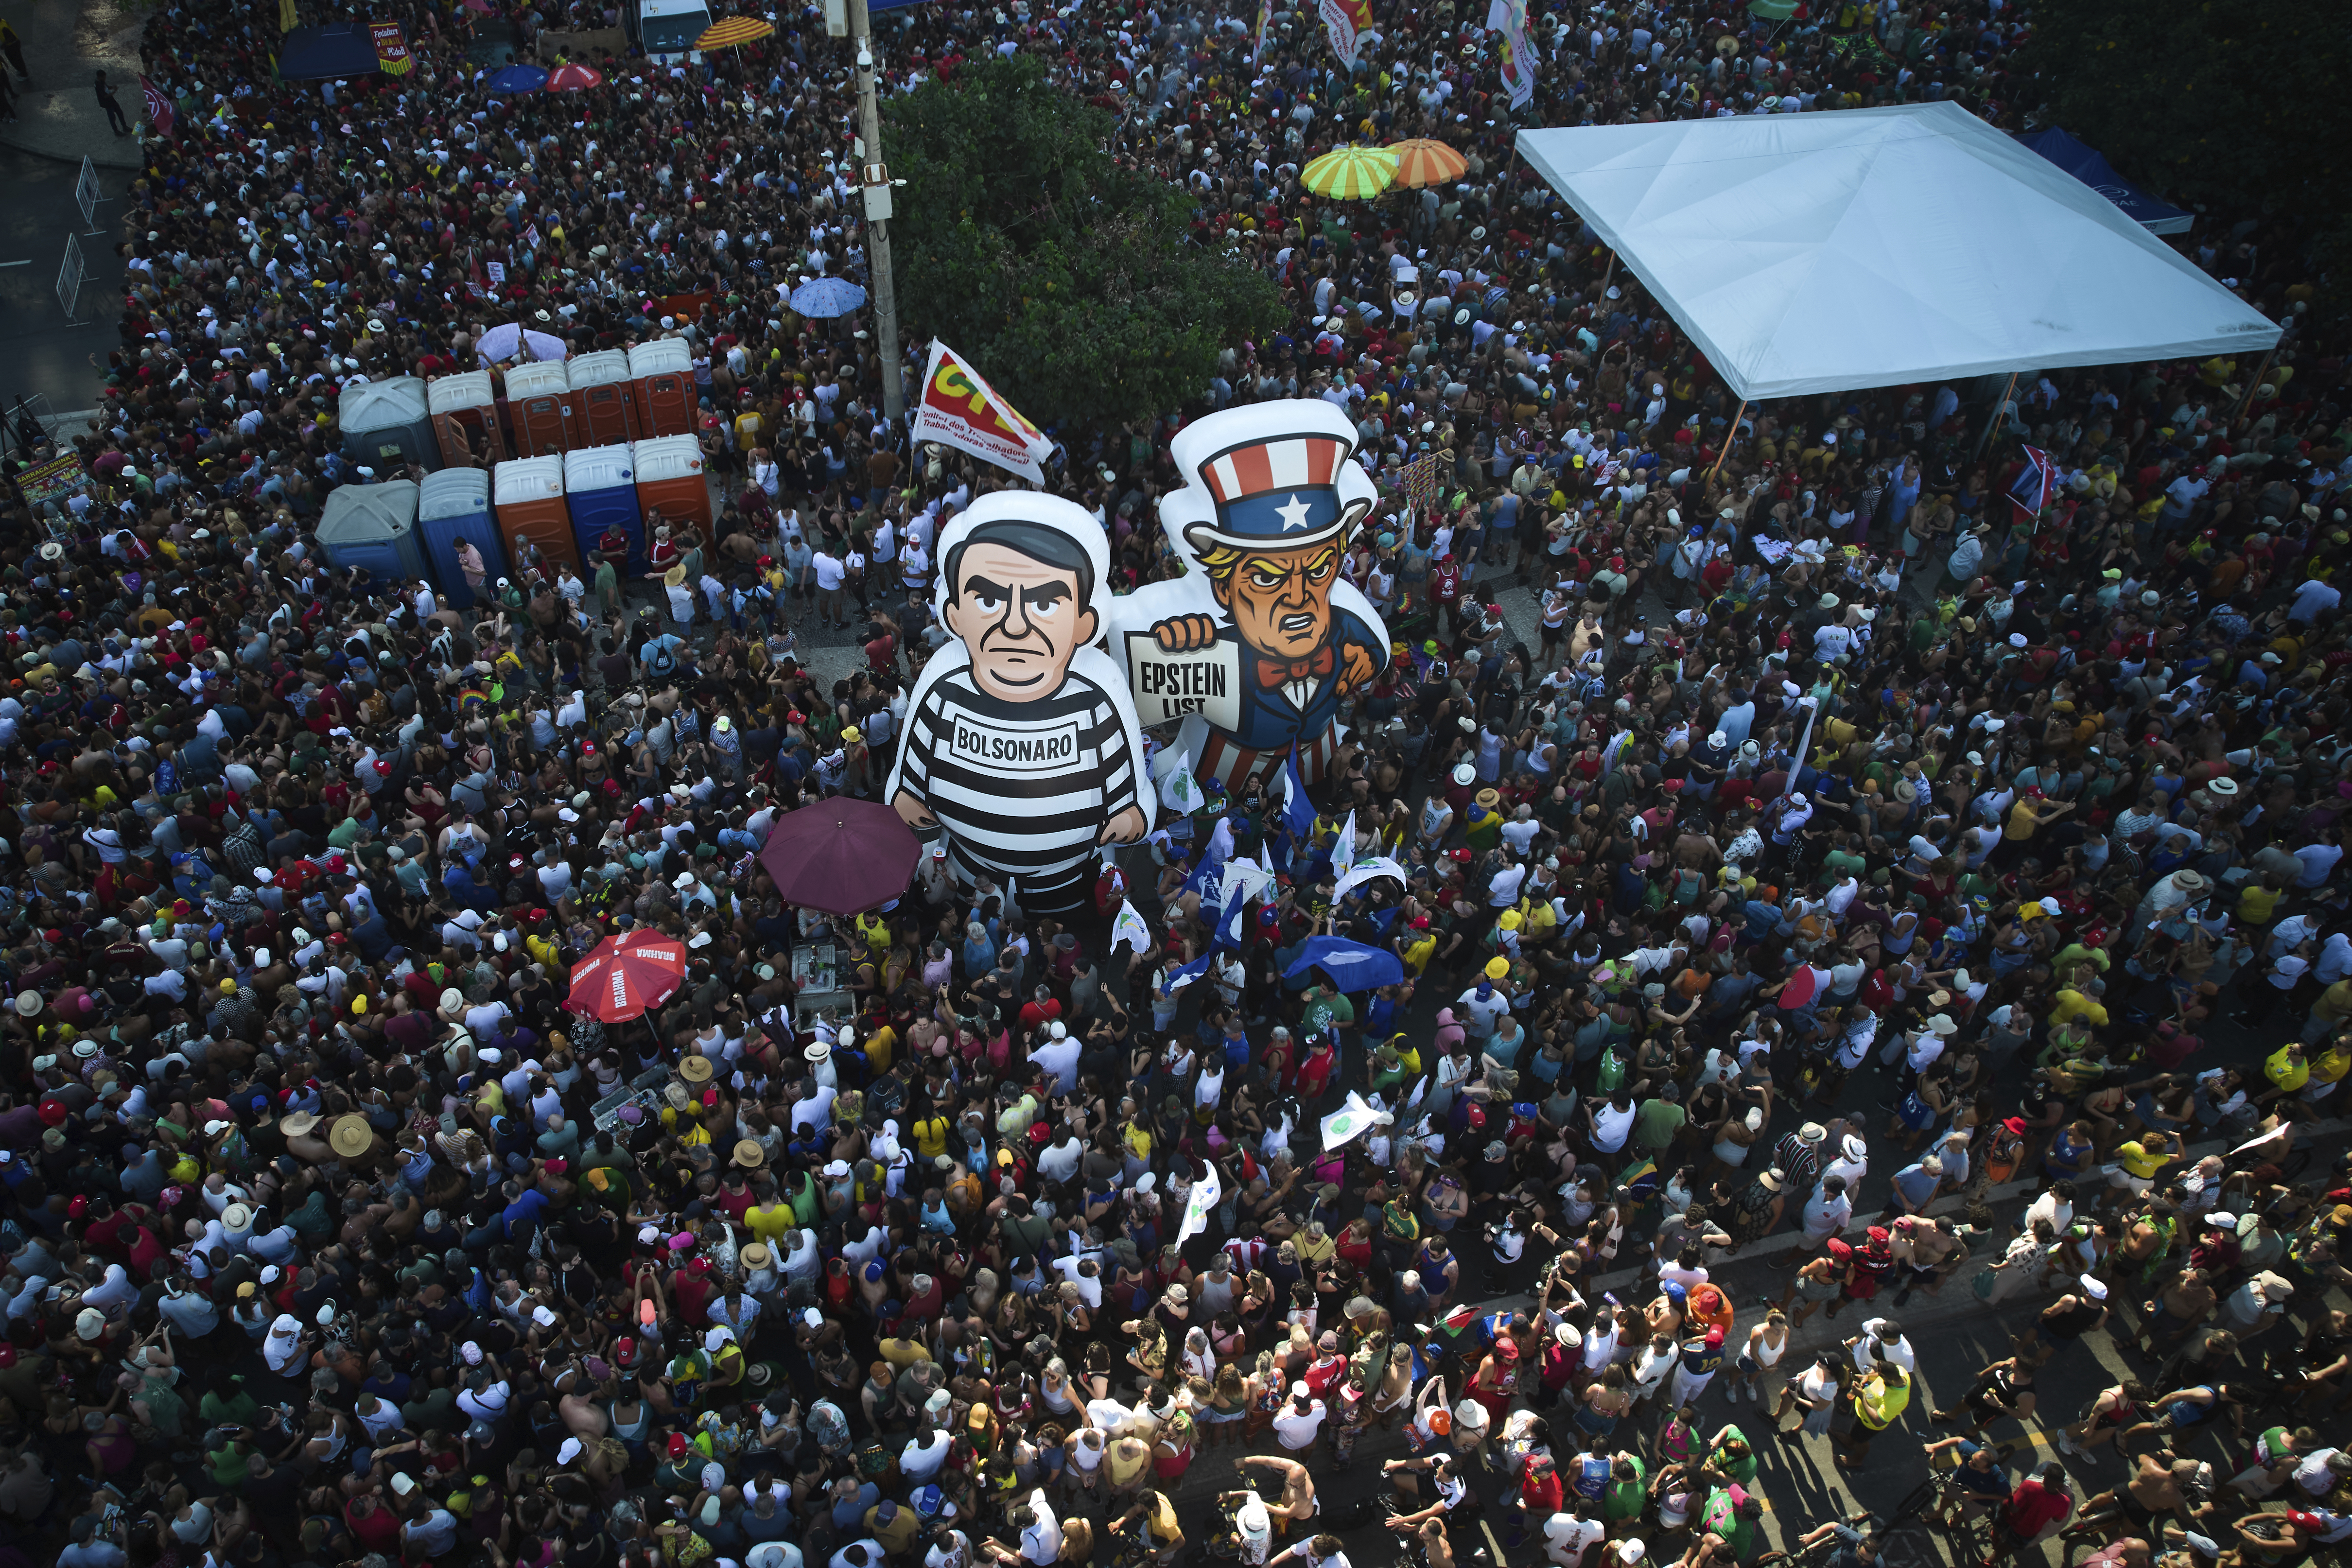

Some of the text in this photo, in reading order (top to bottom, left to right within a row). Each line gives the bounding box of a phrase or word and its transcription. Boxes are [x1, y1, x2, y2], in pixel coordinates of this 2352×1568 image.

[374, 28, 398, 39] Fortalecer
[380, 37, 401, 46] BRASIL
[387, 46, 405, 56] PCdoB
[949, 421, 965, 432] dos
[16, 466, 49, 483] BARRACA
[1141, 661, 1225, 697] EPSTEIN
[1162, 697, 1205, 719] LIST
[957, 726, 1072, 762] BOLSONARO
[637, 949, 676, 961] BRAHMA
[573, 958, 600, 985] BRAHMA
[611, 969, 627, 1009] BRAHMA
[1387, 1216, 1405, 1235] BRASIL
[1699, 1357, 1722, 1372] 12
